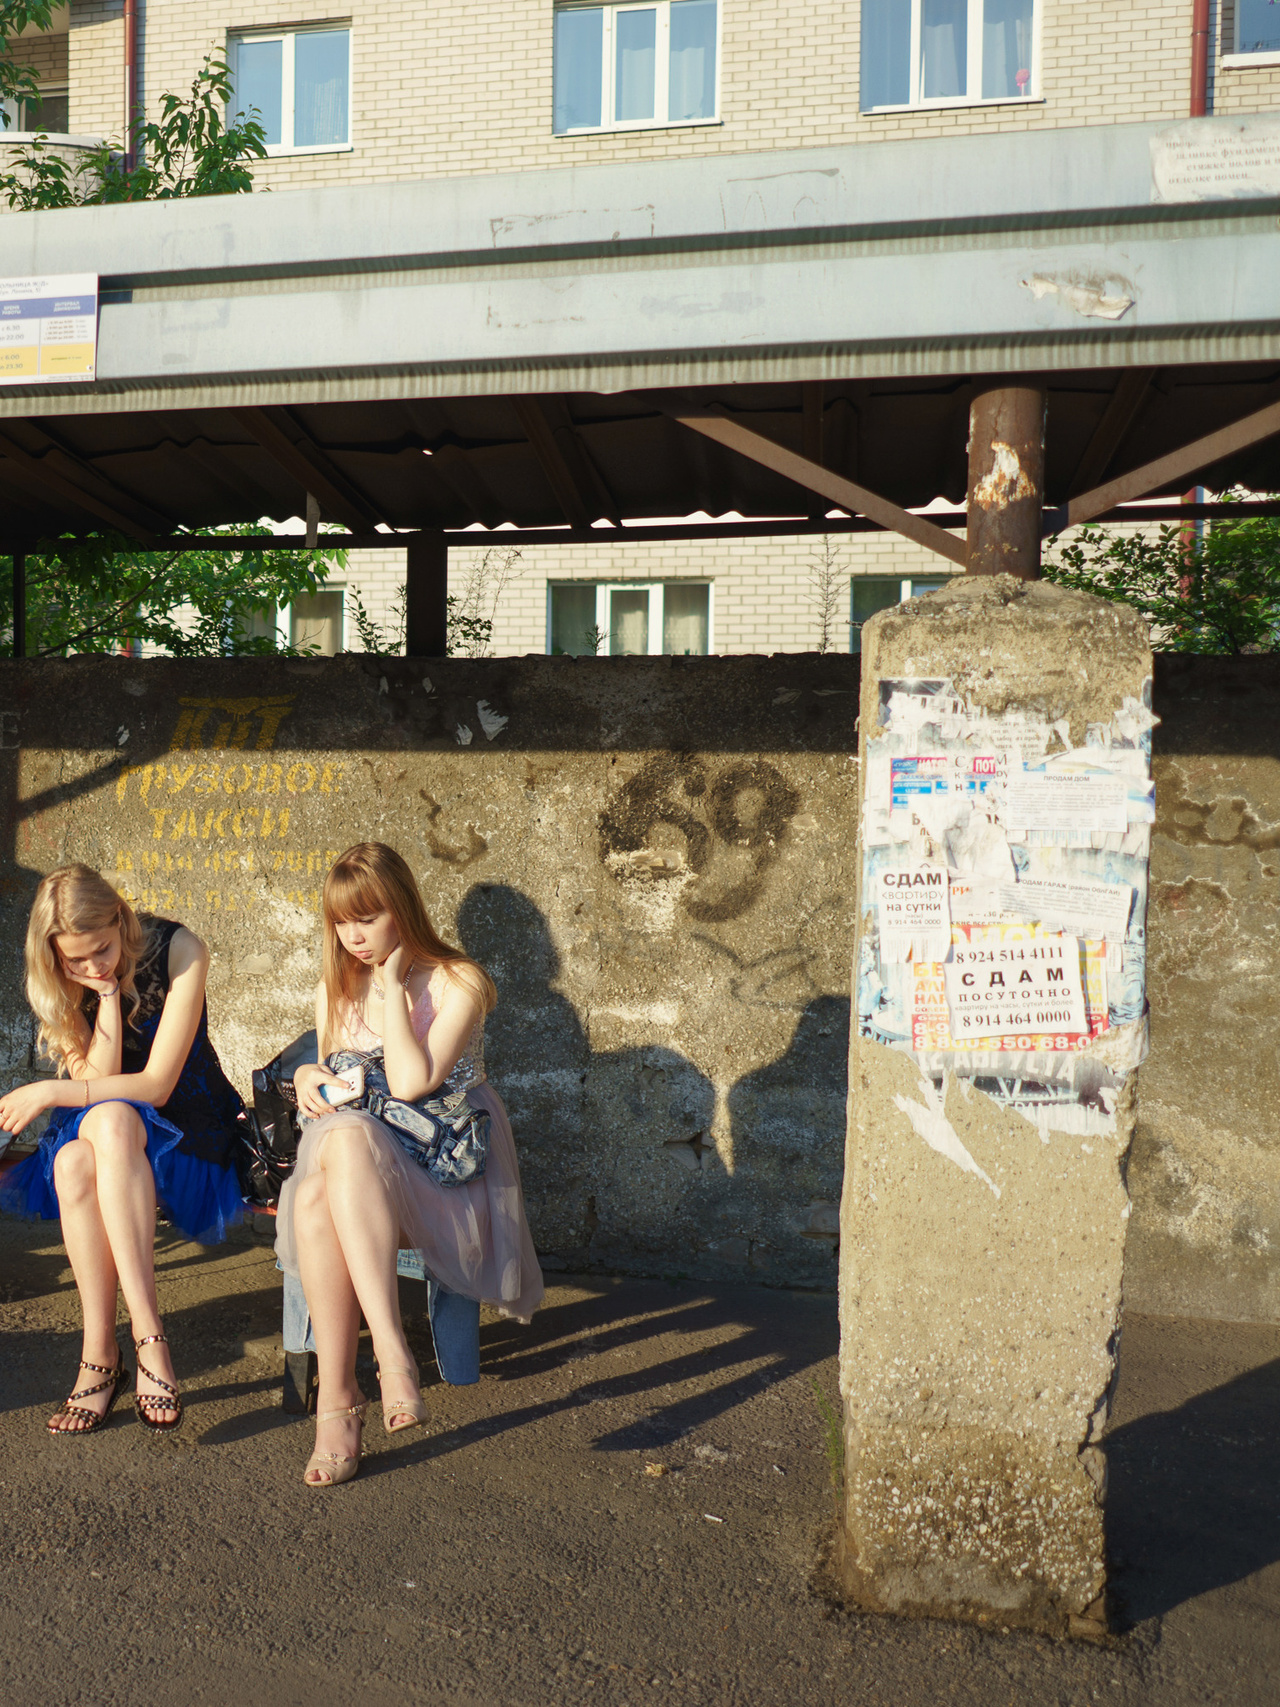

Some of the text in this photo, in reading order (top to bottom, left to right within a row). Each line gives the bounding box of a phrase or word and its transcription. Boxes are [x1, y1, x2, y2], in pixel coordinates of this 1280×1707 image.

[116, 762, 345, 804] ГРУЗОВОЕ
[149, 807, 291, 840] ТАКСИ
[883, 873, 942, 888] СДАМ
[1043, 880, 1067, 889] ГАРАЖ
[886, 903, 941, 913] на сутки
[956, 946, 1063, 964] 8 924 514 4111
[959, 987, 1071, 1002] ПОСУТОЧНО
[955, 1004, 988, 1012] квартиру
[963, 1015, 971, 1027] 8
[975, 1013, 1001, 1026] 914
[1006, 1012, 1031, 1025] 464
[1036, 1010, 1071, 1023] 0000
